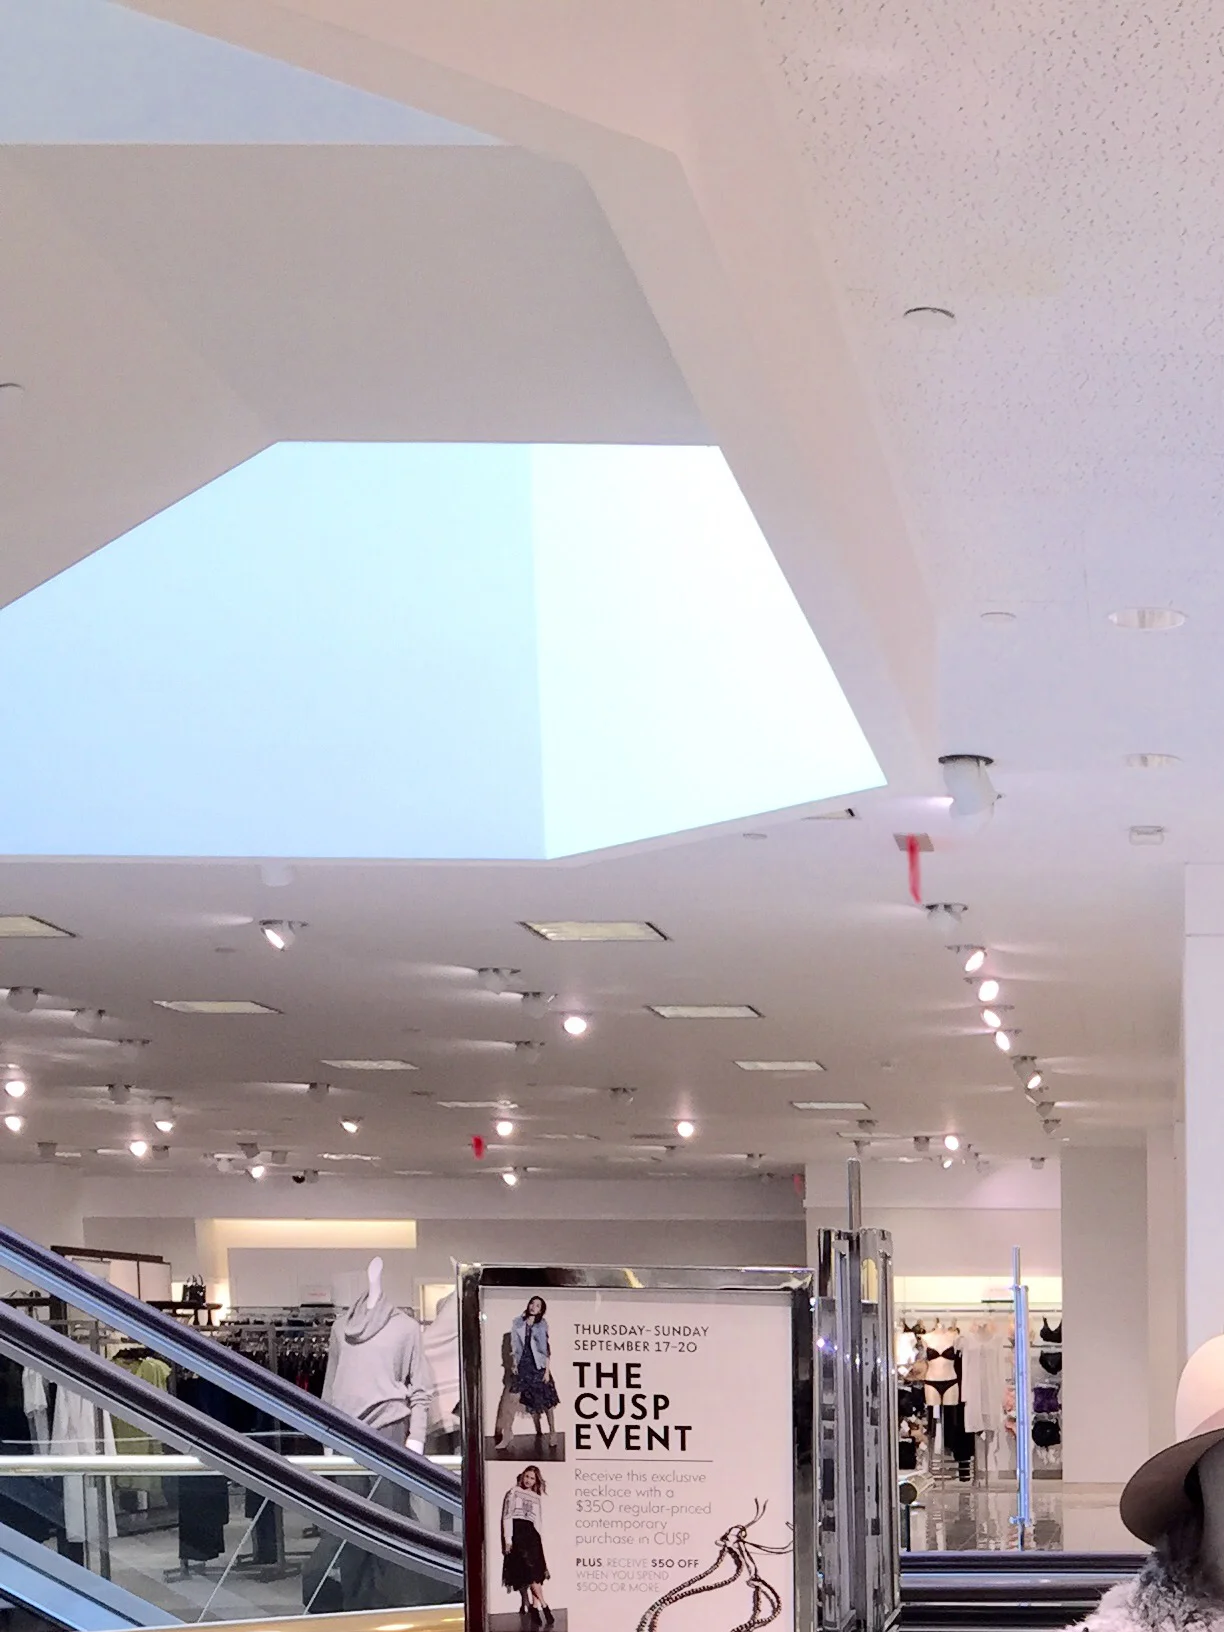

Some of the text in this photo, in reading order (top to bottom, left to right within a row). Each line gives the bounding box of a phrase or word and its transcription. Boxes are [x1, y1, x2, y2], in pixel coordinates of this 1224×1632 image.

[574, 1339, 650, 1352] SEPTEMBER
[572, 1361, 642, 1389] THE
[574, 1392, 670, 1420] CUSP
[575, 1423, 692, 1451] EVENT
[574, 1468, 707, 1483] Receive this exclusive
[574, 1485, 675, 1498] necklace with a
[575, 1499, 712, 1517] $350 regular-priced
[574, 1518, 668, 1531] contemporary
[575, 1532, 691, 1546] purchase in CUSP
[575, 1557, 700, 1569] PLUS RECEIVE $50 OFF
[575, 1569, 670, 1581] WHEN YOU SPEND
[575, 1582, 660, 1593] $500 OR MORE
